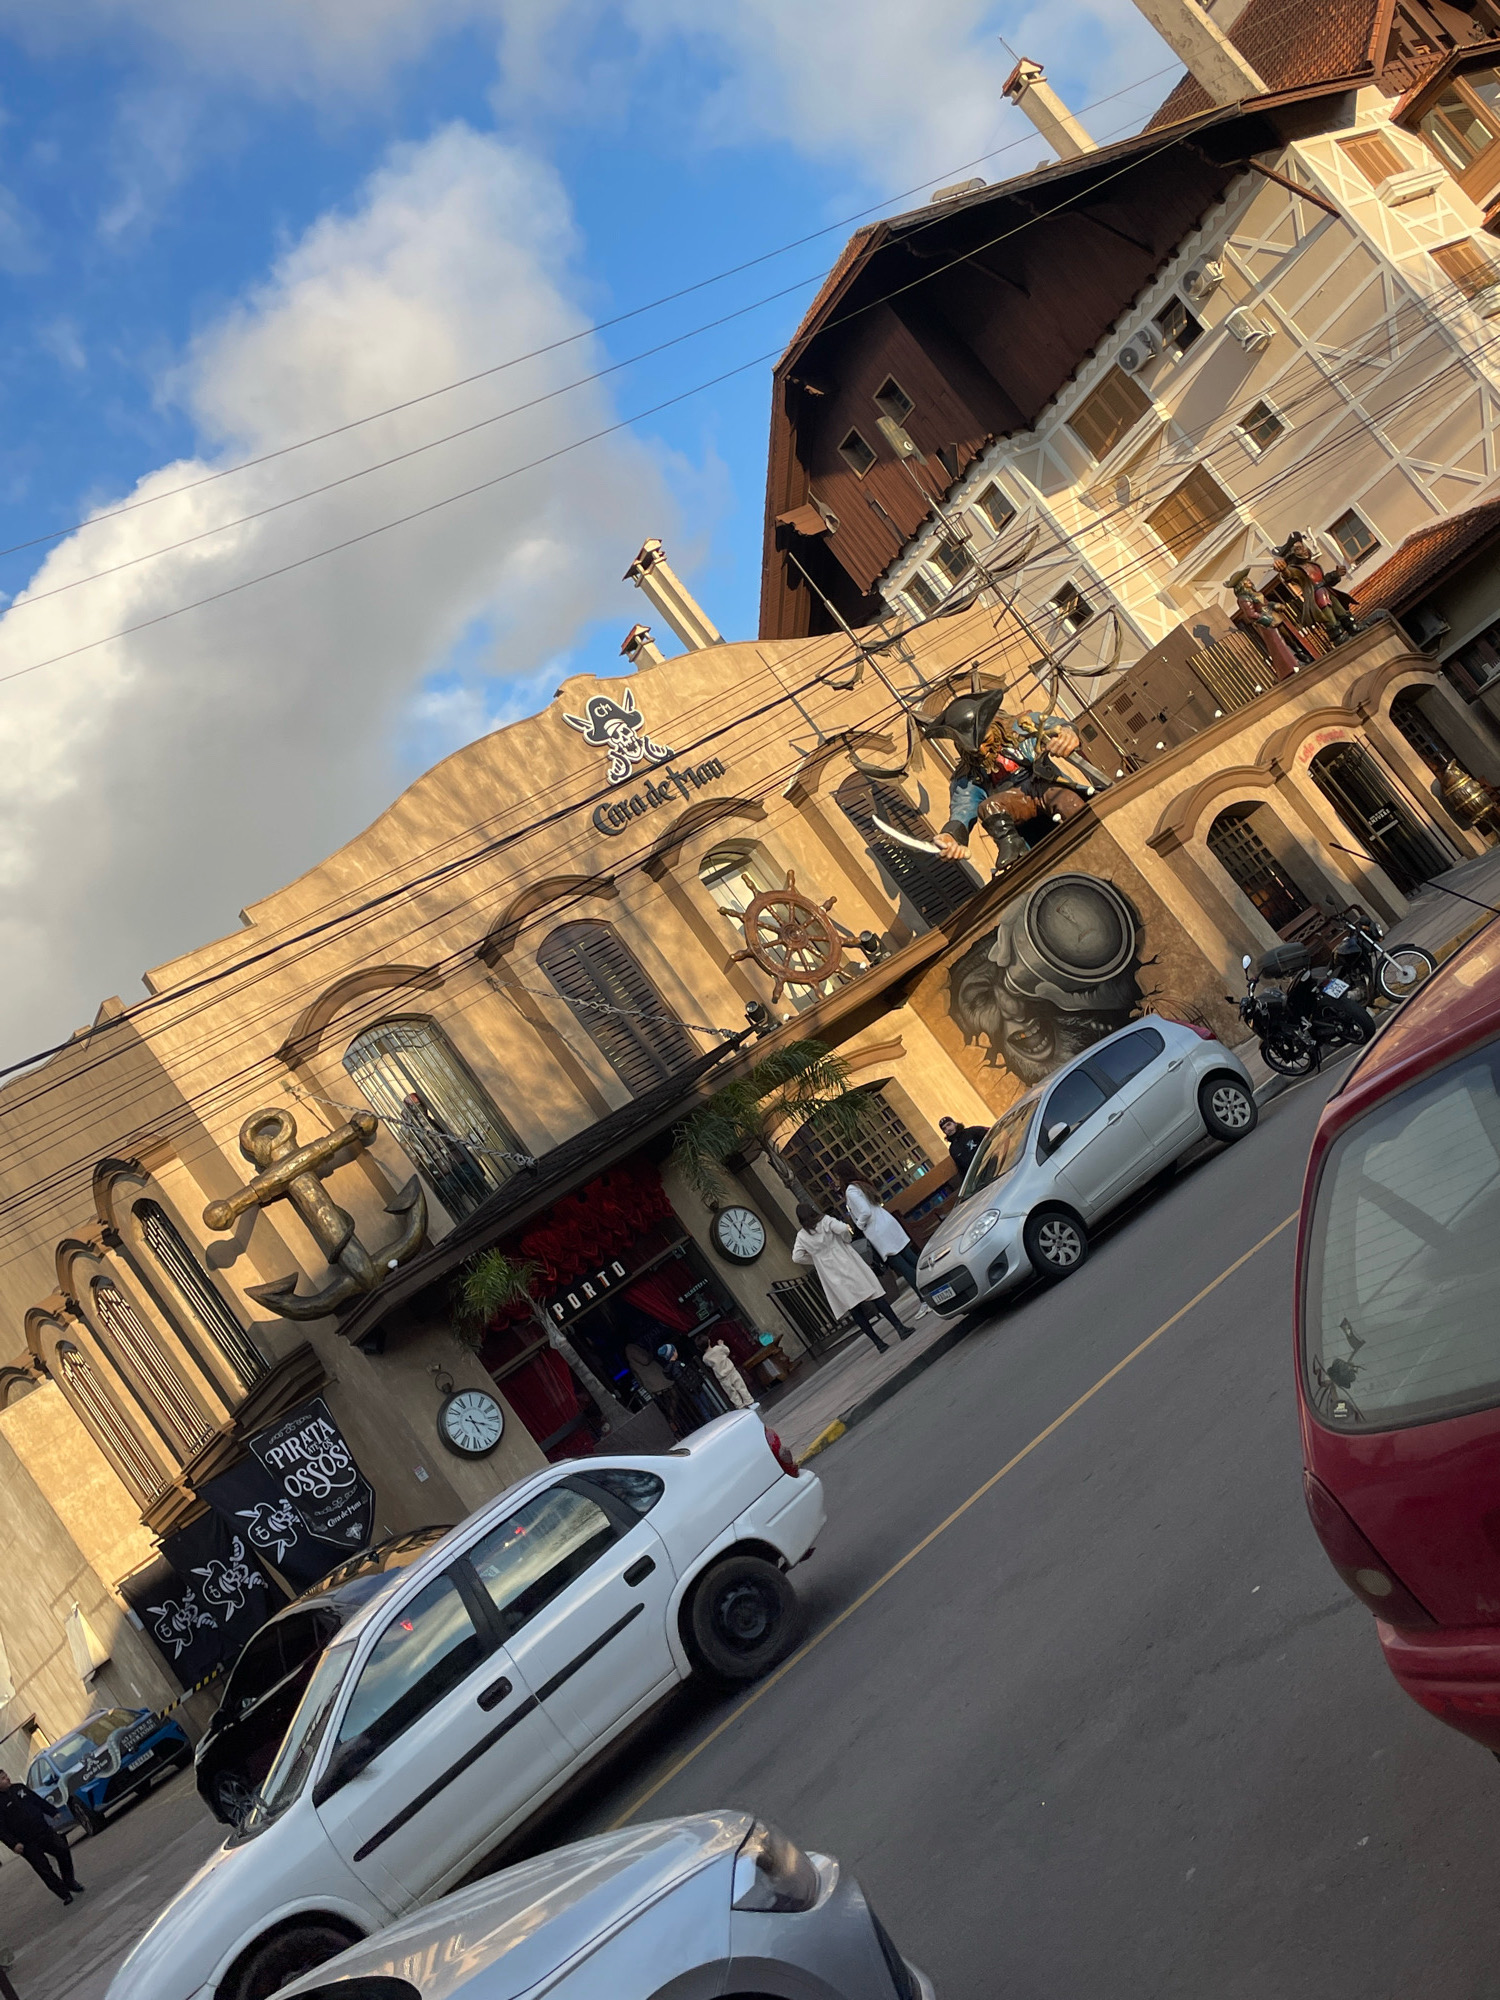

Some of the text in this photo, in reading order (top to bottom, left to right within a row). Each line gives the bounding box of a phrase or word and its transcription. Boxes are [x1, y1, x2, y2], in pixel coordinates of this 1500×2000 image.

[592, 757, 726, 836] Cara de Mau
[552, 1261, 626, 1321] PORTO
[264, 1417, 336, 1470] PIRATA
[284, 1439, 355, 1498] OSSOS!
[322, 1438, 334, 1450] OS
